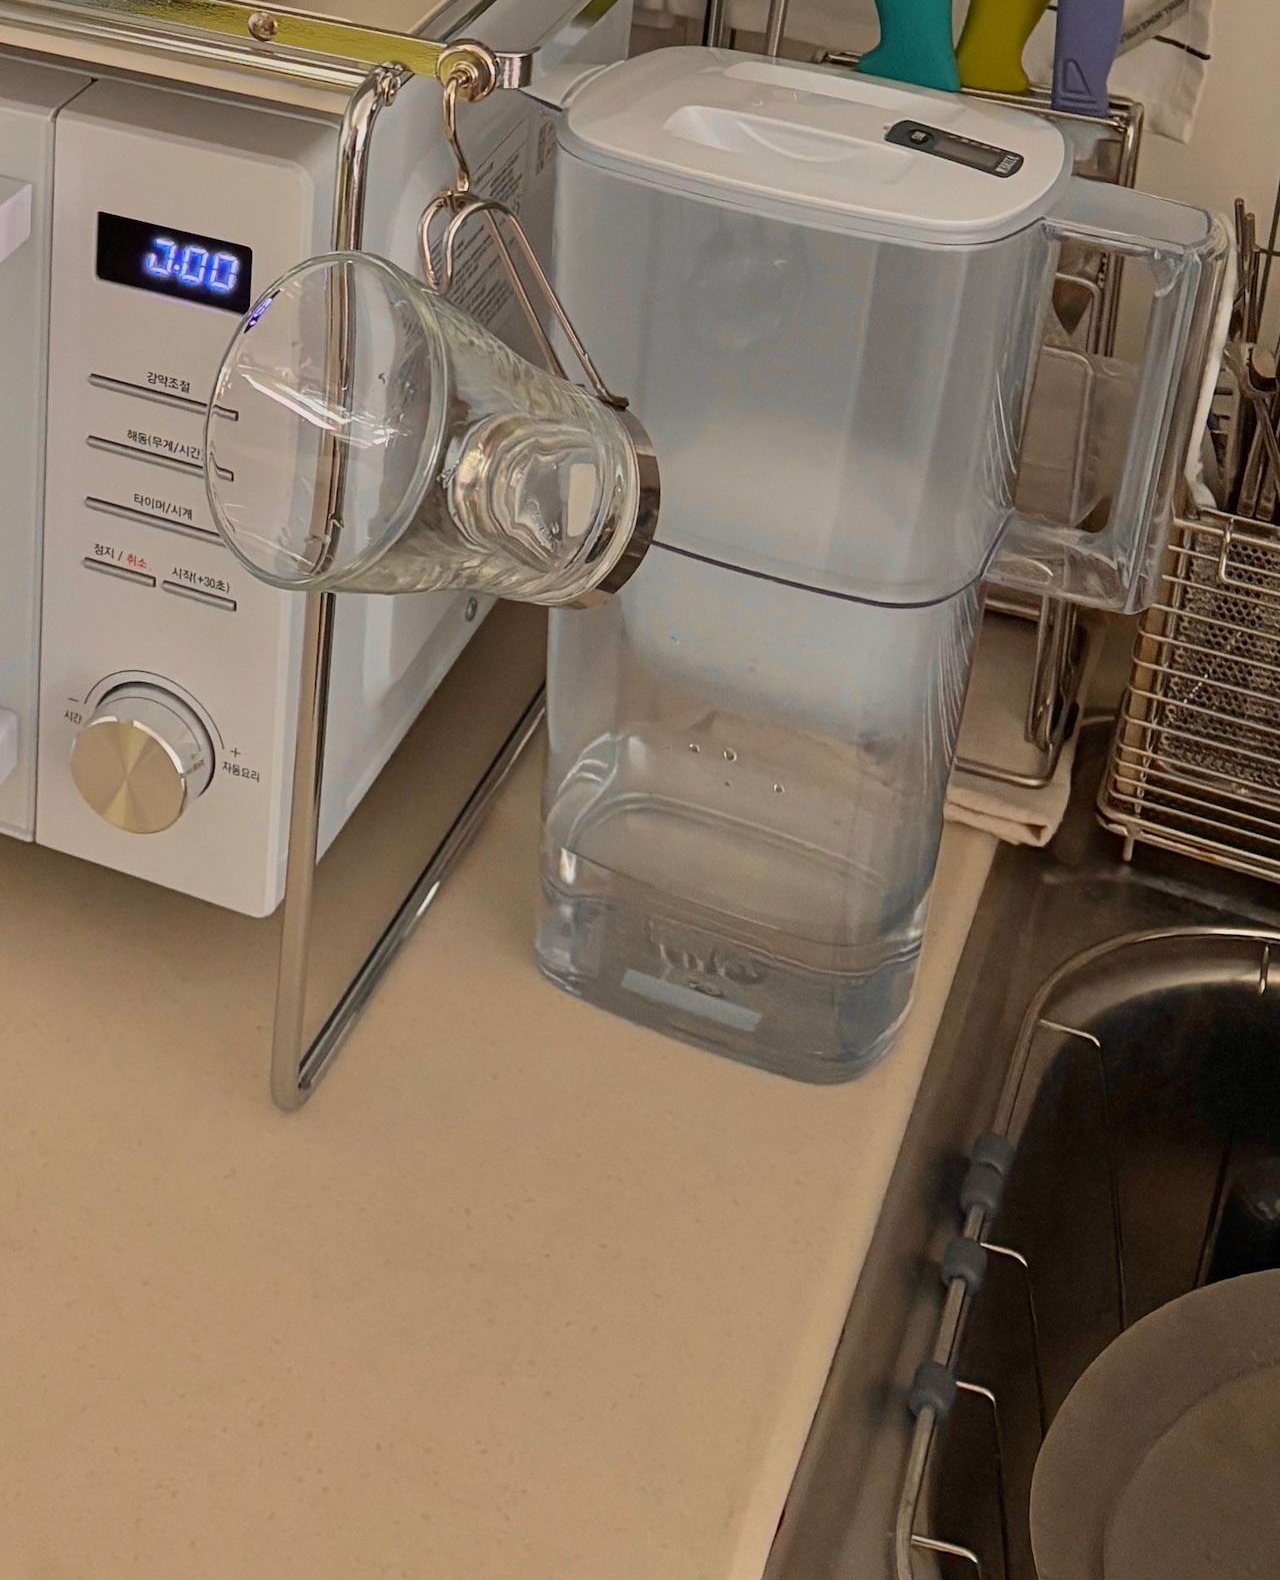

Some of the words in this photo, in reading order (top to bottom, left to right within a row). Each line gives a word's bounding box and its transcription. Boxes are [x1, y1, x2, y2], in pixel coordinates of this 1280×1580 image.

[146, 371, 191, 394] 강약조절
[133, 493, 193, 521] 타이머/시계
[93, 543, 115, 559] 정지
[126, 553, 148, 569] 취소
[222, 761, 260, 783] 자동요리
